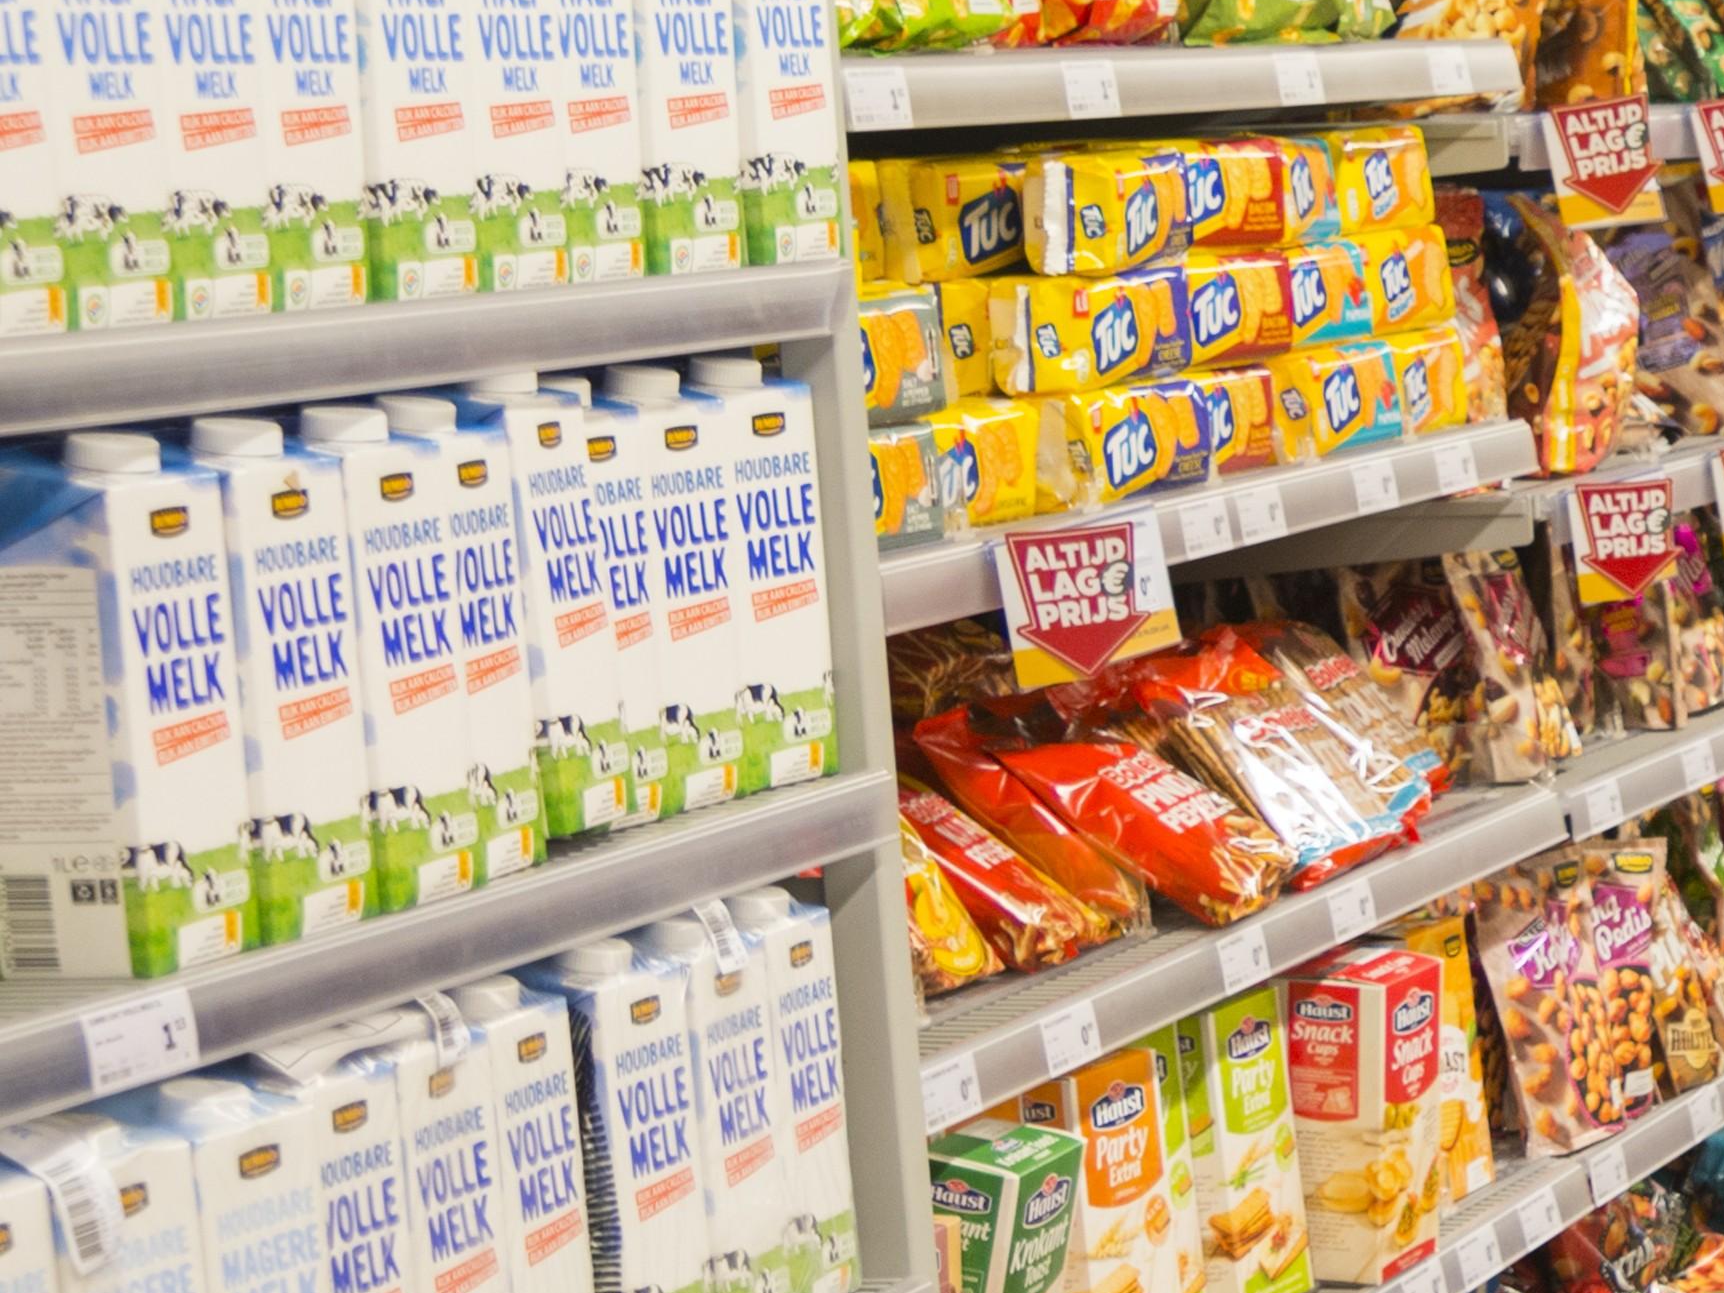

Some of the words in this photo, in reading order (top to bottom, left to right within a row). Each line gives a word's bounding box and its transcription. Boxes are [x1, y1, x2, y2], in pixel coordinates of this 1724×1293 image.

[167, 15, 253, 65] VOLLE
[757, 6, 823, 48] VOLLE
[778, 52, 811, 77] MELK
[195, 71, 237, 97] MELK
[1568, 105, 1642, 138] ALTIJD
[1578, 150, 1646, 180] PRIJS
[735, 453, 811, 483] HOUDBARE
[737, 485, 816, 532] VOLLE
[747, 534, 814, 580] MELK
[1025, 539, 1126, 571] ALTIJD
[132, 555, 218, 592] HOUDBARE
[134, 595, 225, 656] VOLLE
[1037, 597, 1128, 629] PRIJS
[146, 654, 225, 713] MELK
[1299, 1002, 1351, 1019] Haust
[1228, 1022, 1272, 1055] Haust
[1291, 1022, 1353, 1044] Snack
[1306, 1040, 1339, 1057] Cups
[1231, 1058, 1275, 1097] Party
[1092, 1090, 1144, 1127] Haust
[1244, 1078, 1272, 1113] Extra
[1096, 1126, 1148, 1174] Party
[1109, 1158, 1142, 1188] Extra
[222, 1229, 319, 1289] MAGERE
[1009, 1219, 1069, 1278] Krokant
[1025, 1249, 1056, 1285] Toast
